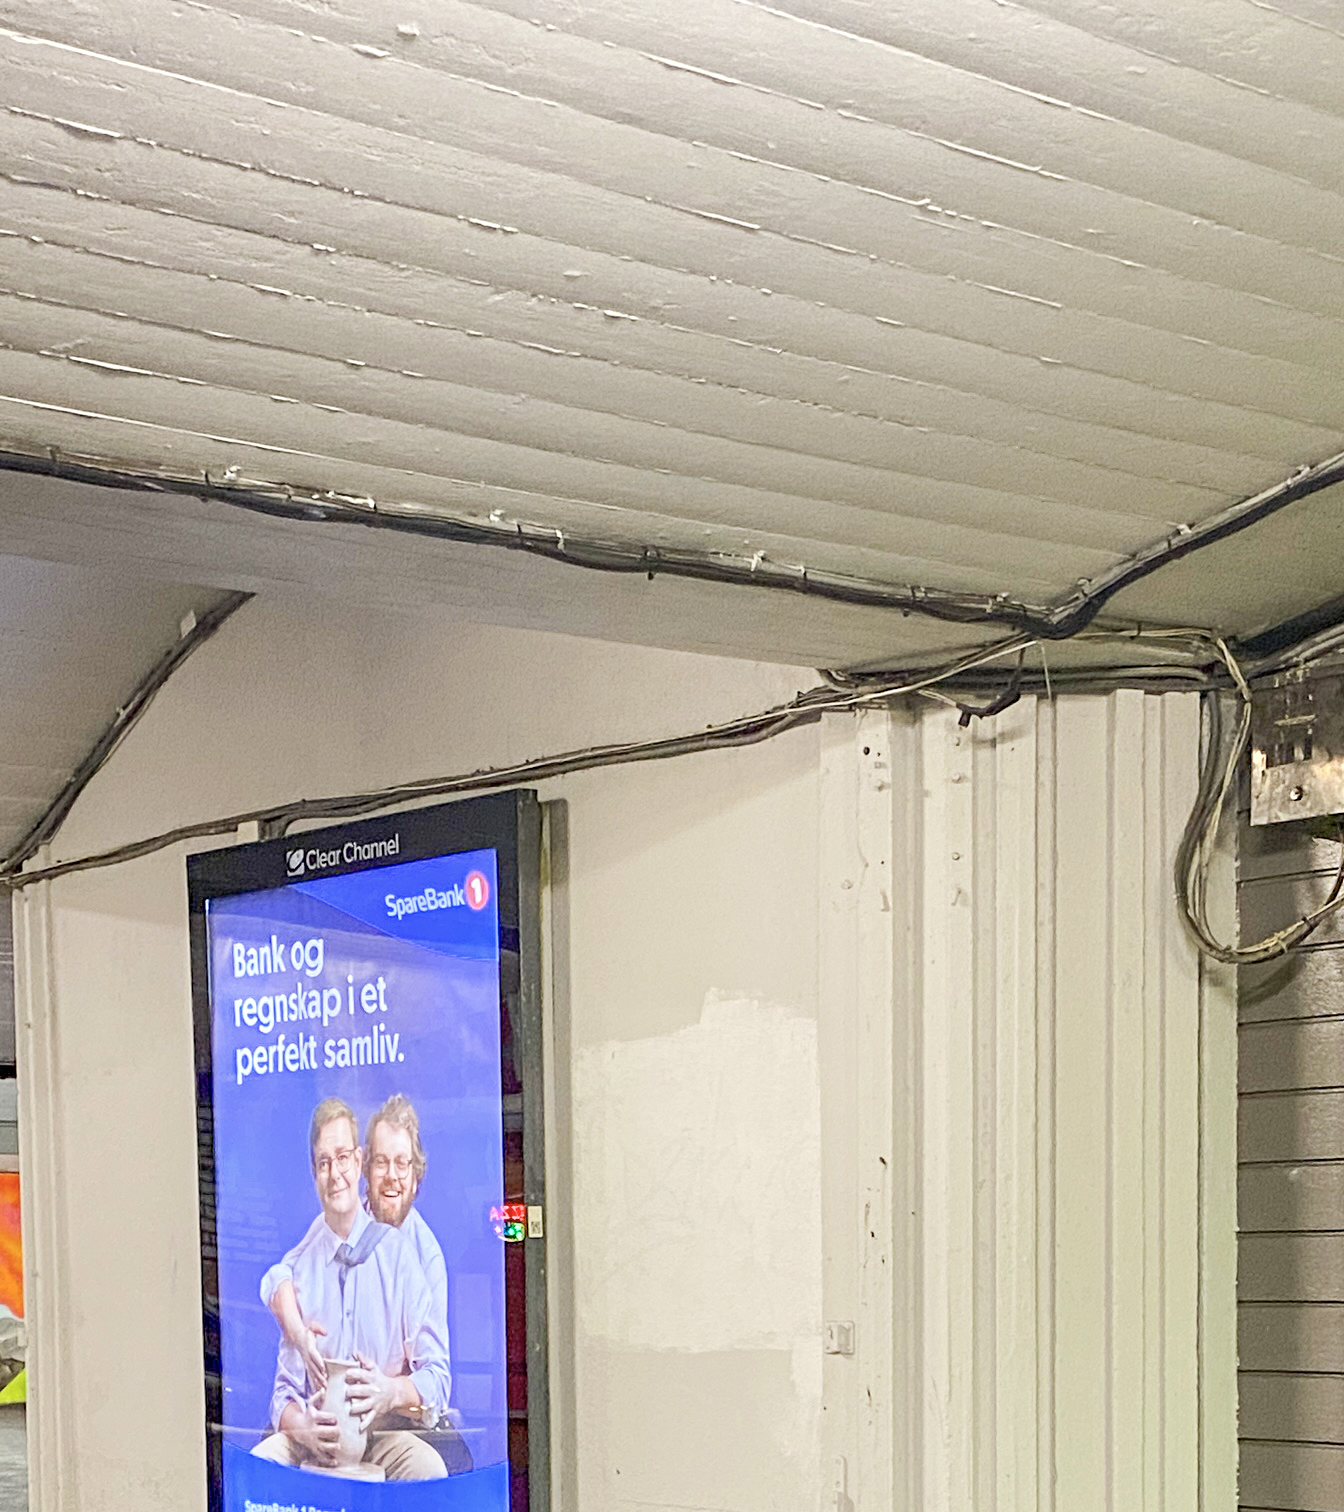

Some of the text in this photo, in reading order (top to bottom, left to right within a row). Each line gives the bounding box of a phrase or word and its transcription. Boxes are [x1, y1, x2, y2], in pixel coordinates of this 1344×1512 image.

[306, 833, 400, 870] Clear Channel
[385, 883, 465, 920] SpareBank
[233, 935, 324, 978] Bank og
[234, 974, 388, 1034] regnskap i et
[236, 1022, 405, 1085] perfekt samliv.
